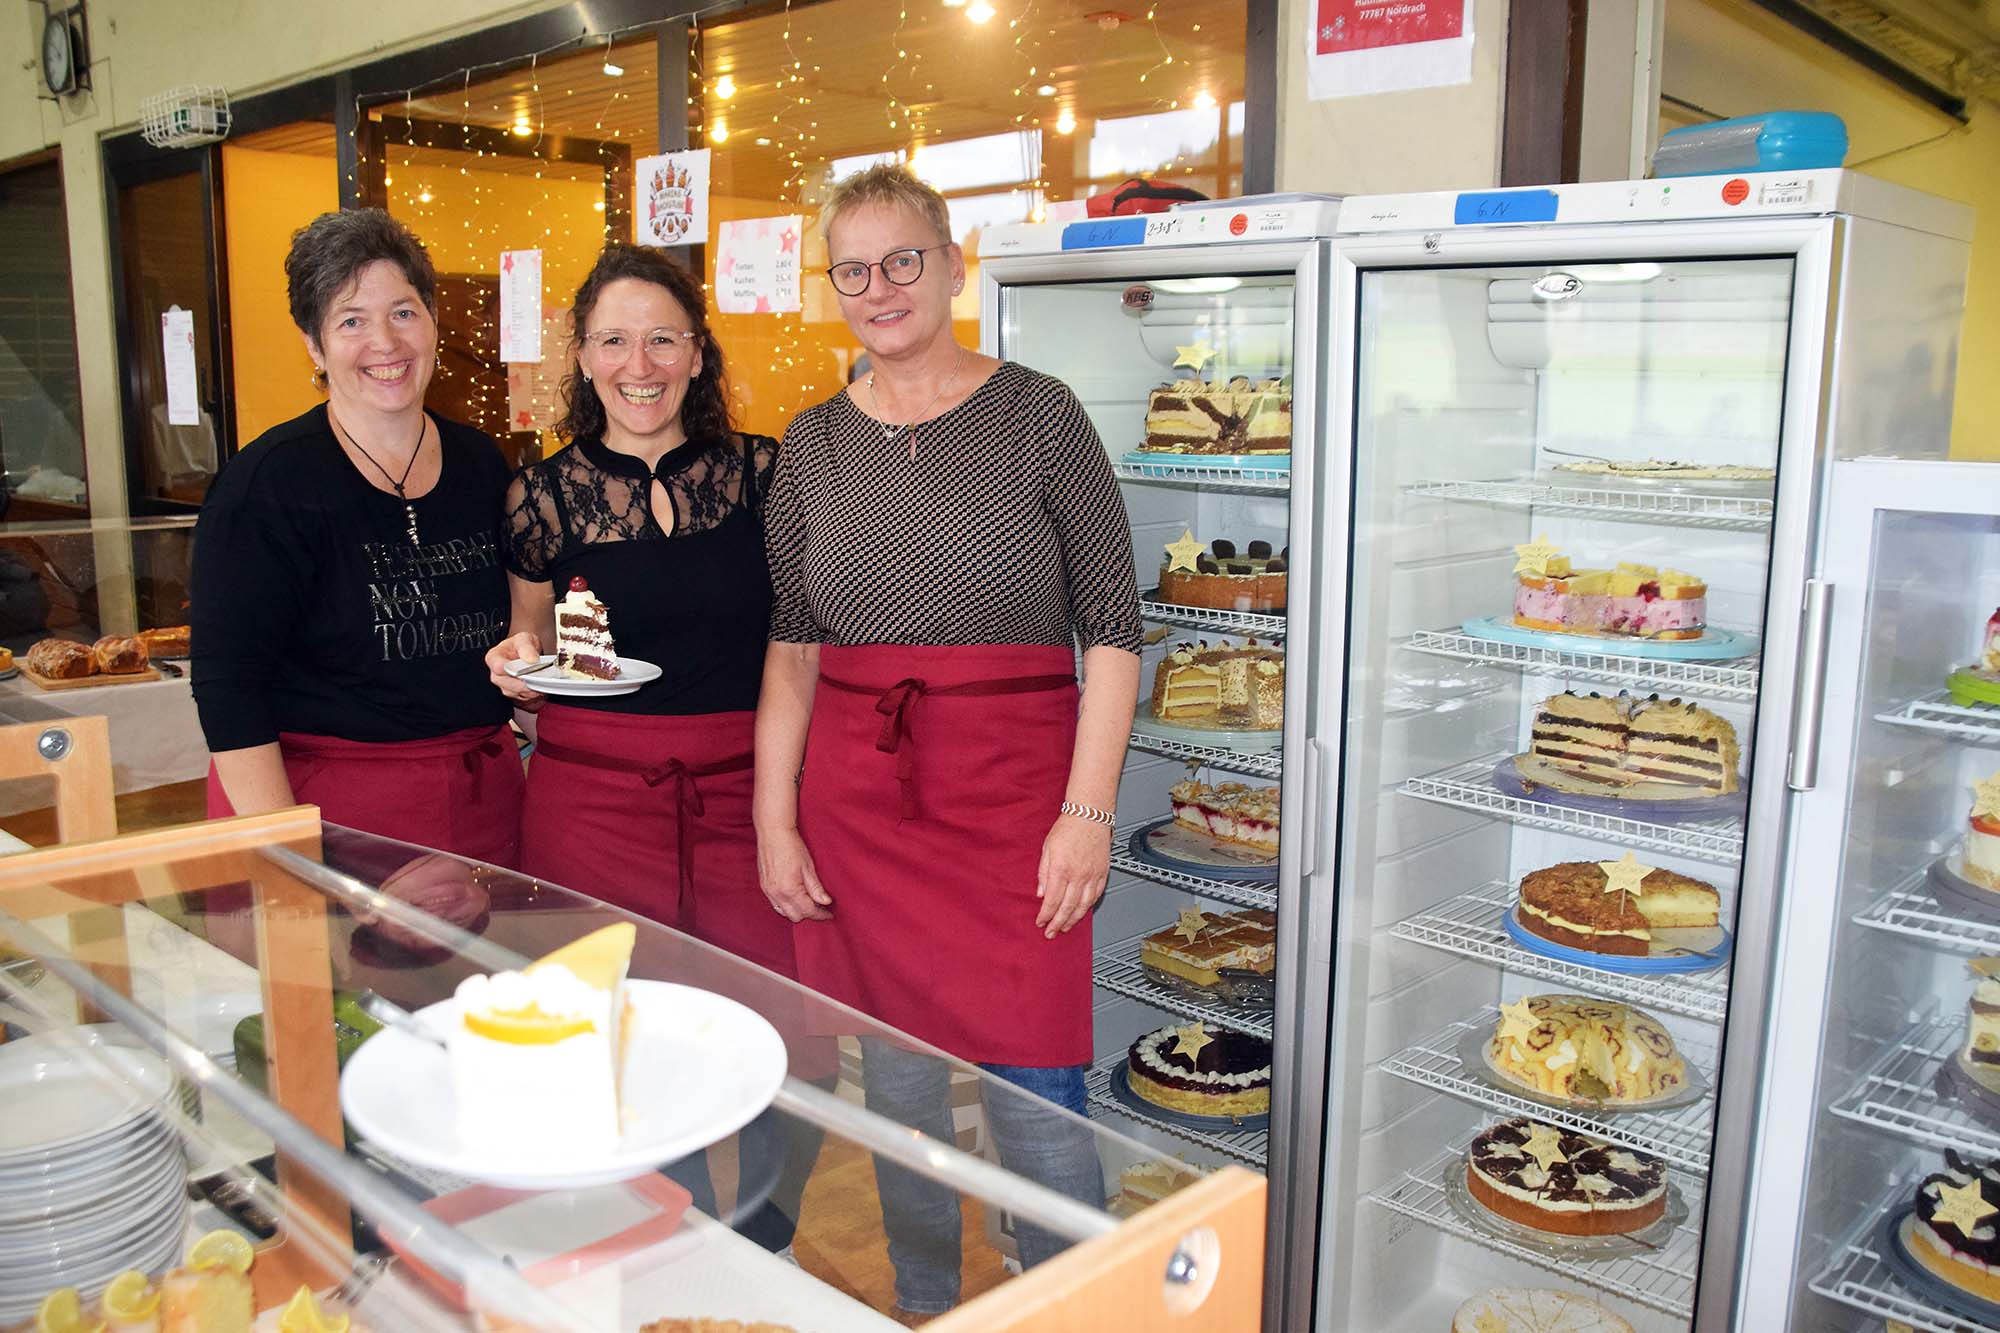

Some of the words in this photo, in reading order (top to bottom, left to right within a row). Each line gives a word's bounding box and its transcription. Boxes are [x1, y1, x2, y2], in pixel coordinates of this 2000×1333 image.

[1359, 7, 1385, 20] 77787
[1386, 2, 1426, 17] Nordrach
[368, 579, 440, 622] NOW
